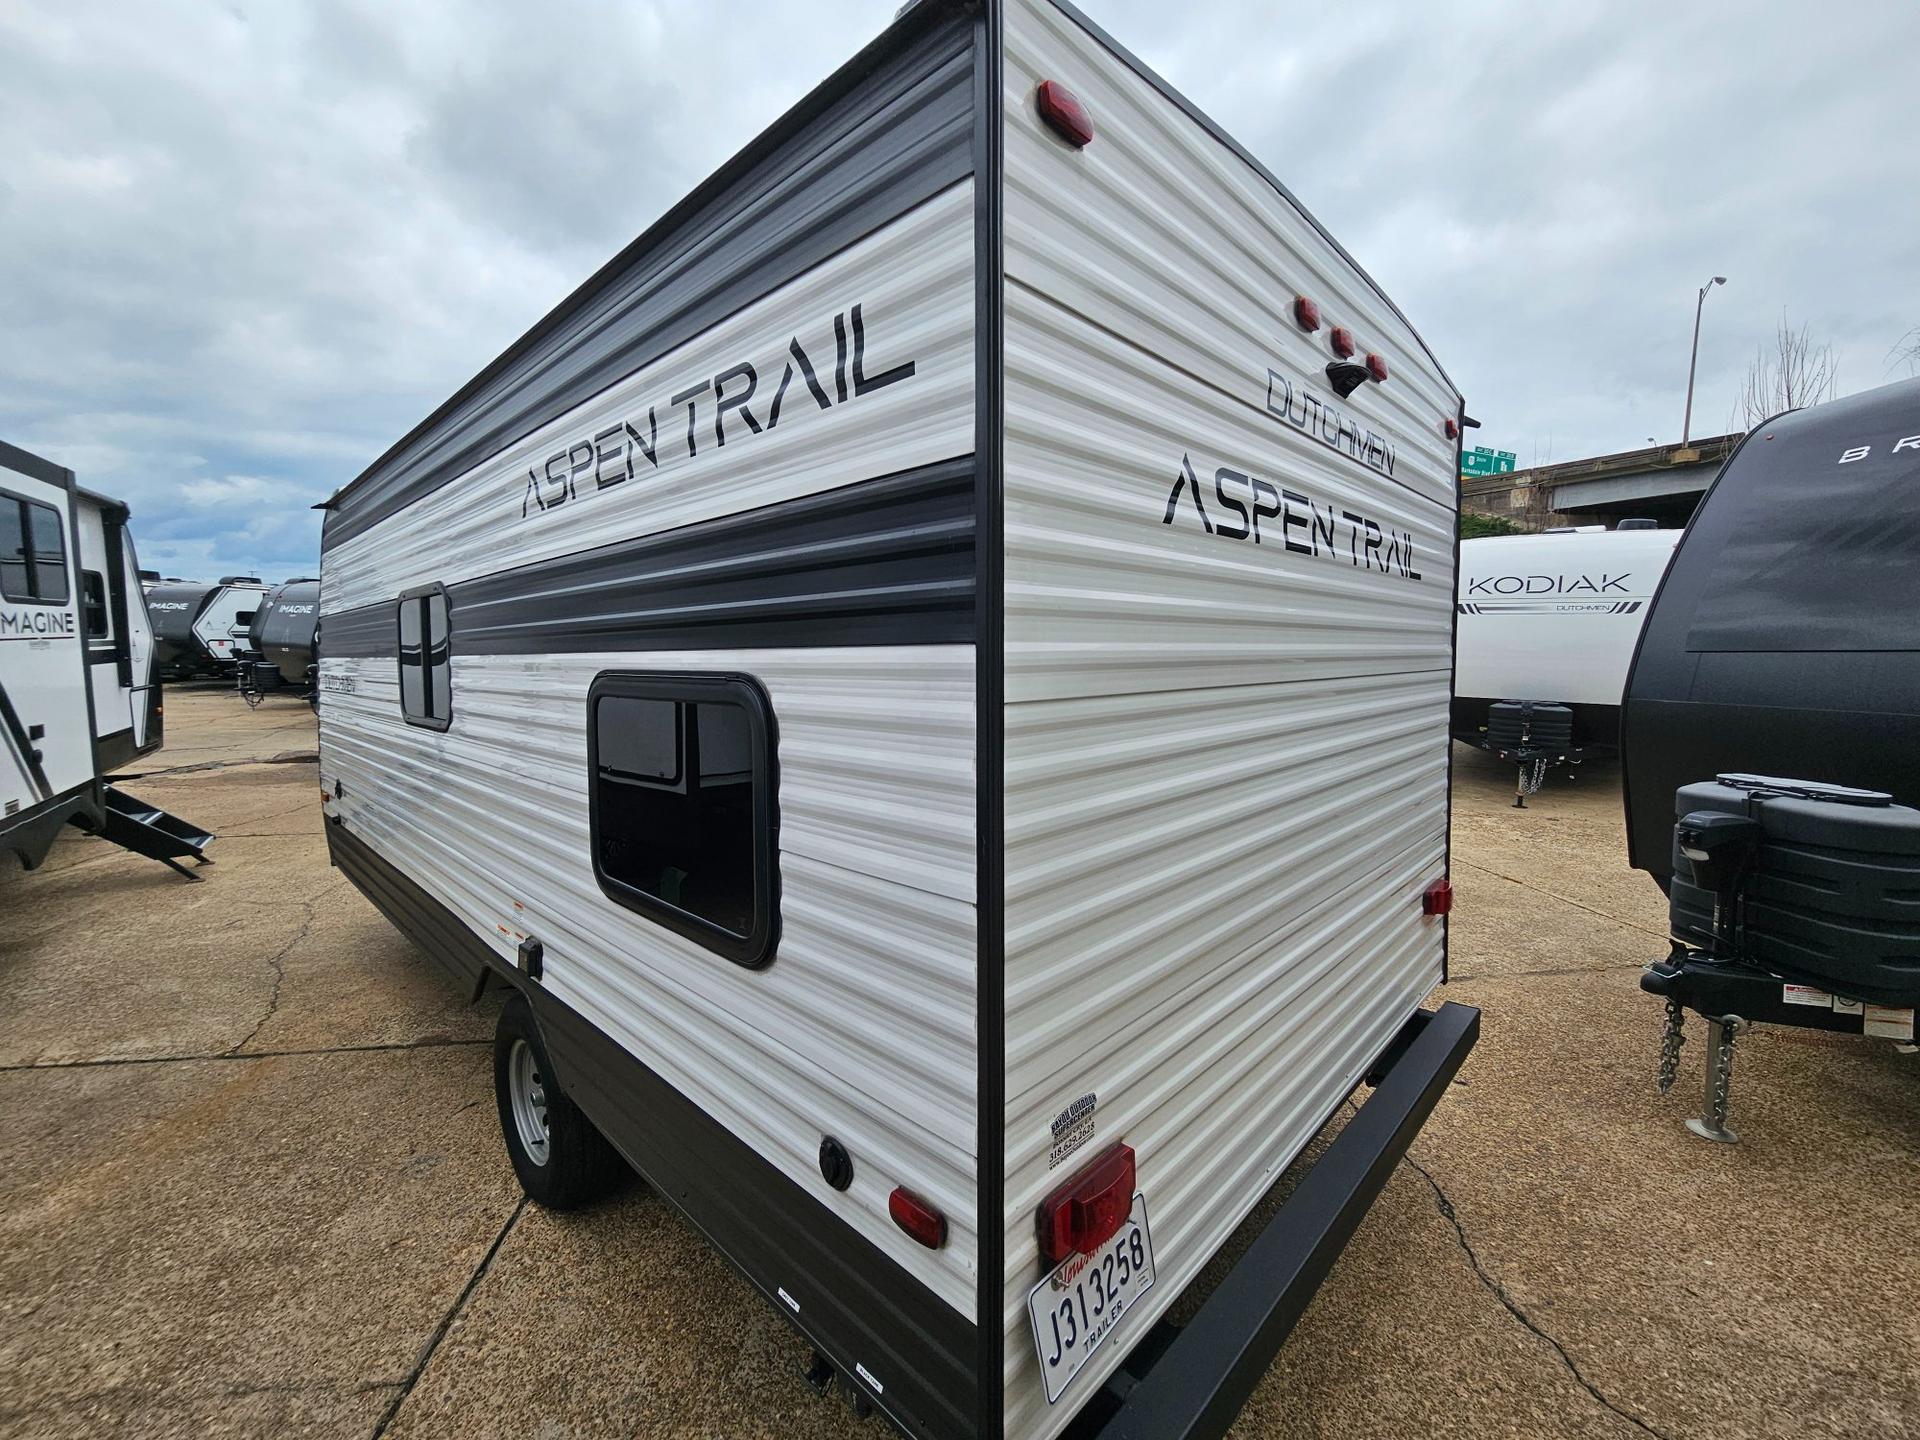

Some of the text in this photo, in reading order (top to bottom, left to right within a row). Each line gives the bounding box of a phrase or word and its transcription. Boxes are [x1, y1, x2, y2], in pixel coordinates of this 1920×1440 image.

[522, 303, 916, 518] ASPEN TRAIL
[1266, 368, 1396, 476] DUTCHMEN
[1162, 452, 1422, 581] ASPEN TRAIL
[150, 602, 189, 610] IMAGINE
[1468, 573, 1632, 595] KODIAK
[279, 604, 314, 614] IMAGINE
[1050, 1093, 1097, 1135] BAYOU OUTDOOR
[1053, 1103, 1095, 1139] SUPERCENTER
[1049, 1227, 1144, 1367] J313258
[1083, 1300, 1123, 1352] TRAILER
